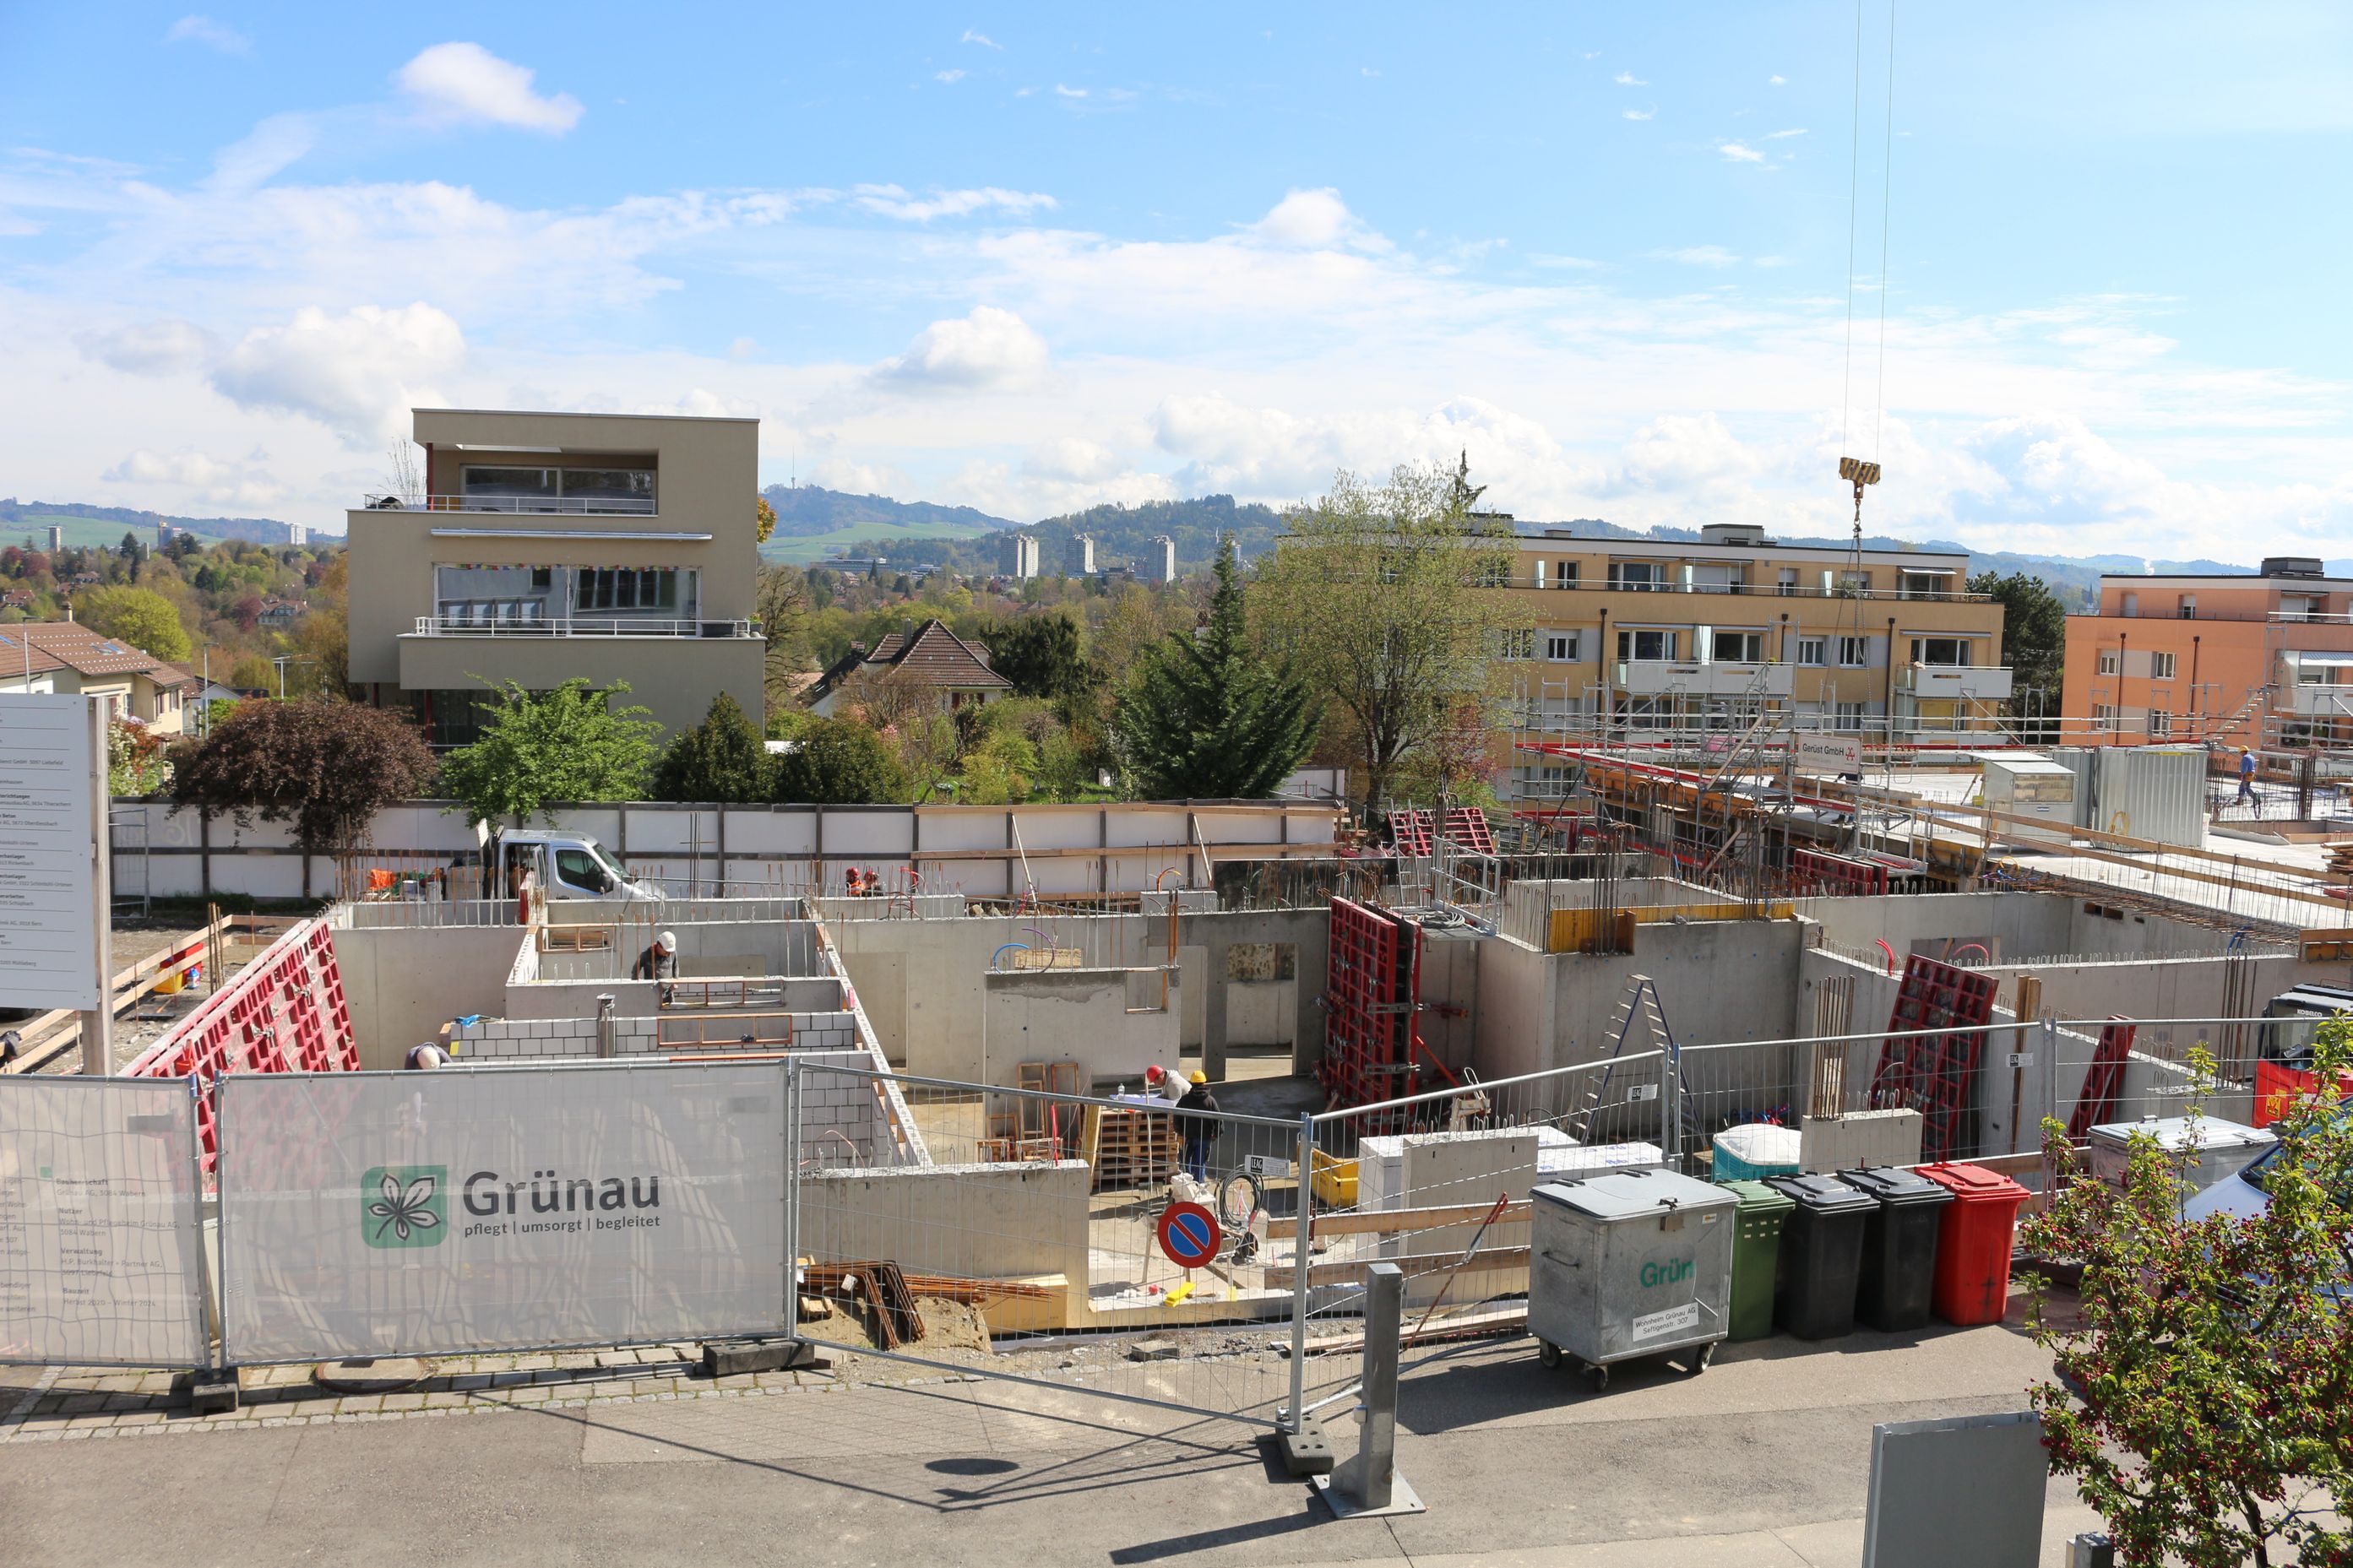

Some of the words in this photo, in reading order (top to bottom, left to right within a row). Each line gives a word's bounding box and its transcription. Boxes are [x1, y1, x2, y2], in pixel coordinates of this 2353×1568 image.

[1802, 743, 1823, 754] Gerüst
[1824, 746, 1845, 757] GmbH
[2296, 1008, 2323, 1017] KOBELCO
[463, 1169, 660, 1216] Grünau
[58, 1207, 83, 1215] Nutzer
[465, 1222, 508, 1238] pflegt
[521, 1218, 582, 1234] umsorgt
[595, 1215, 660, 1230] begleitet
[79, 1229, 106, 1238] Wabern
[61, 1247, 103, 1257] Verwaltung
[62, 1287, 90, 1295] Bauzeit
[64, 1297, 86, 1305] Herbst
[87, 1298, 106, 1306] 2020
[113, 1299, 138, 1307] Winter
[1635, 1315, 1665, 1328] Wohnheim
[1666, 1310, 1686, 1321] Grünau
[1687, 1306, 1697, 1316] AG
[1643, 1321, 1676, 1335] Seftigenstr.
[1676, 1316, 1689, 1326] 307
